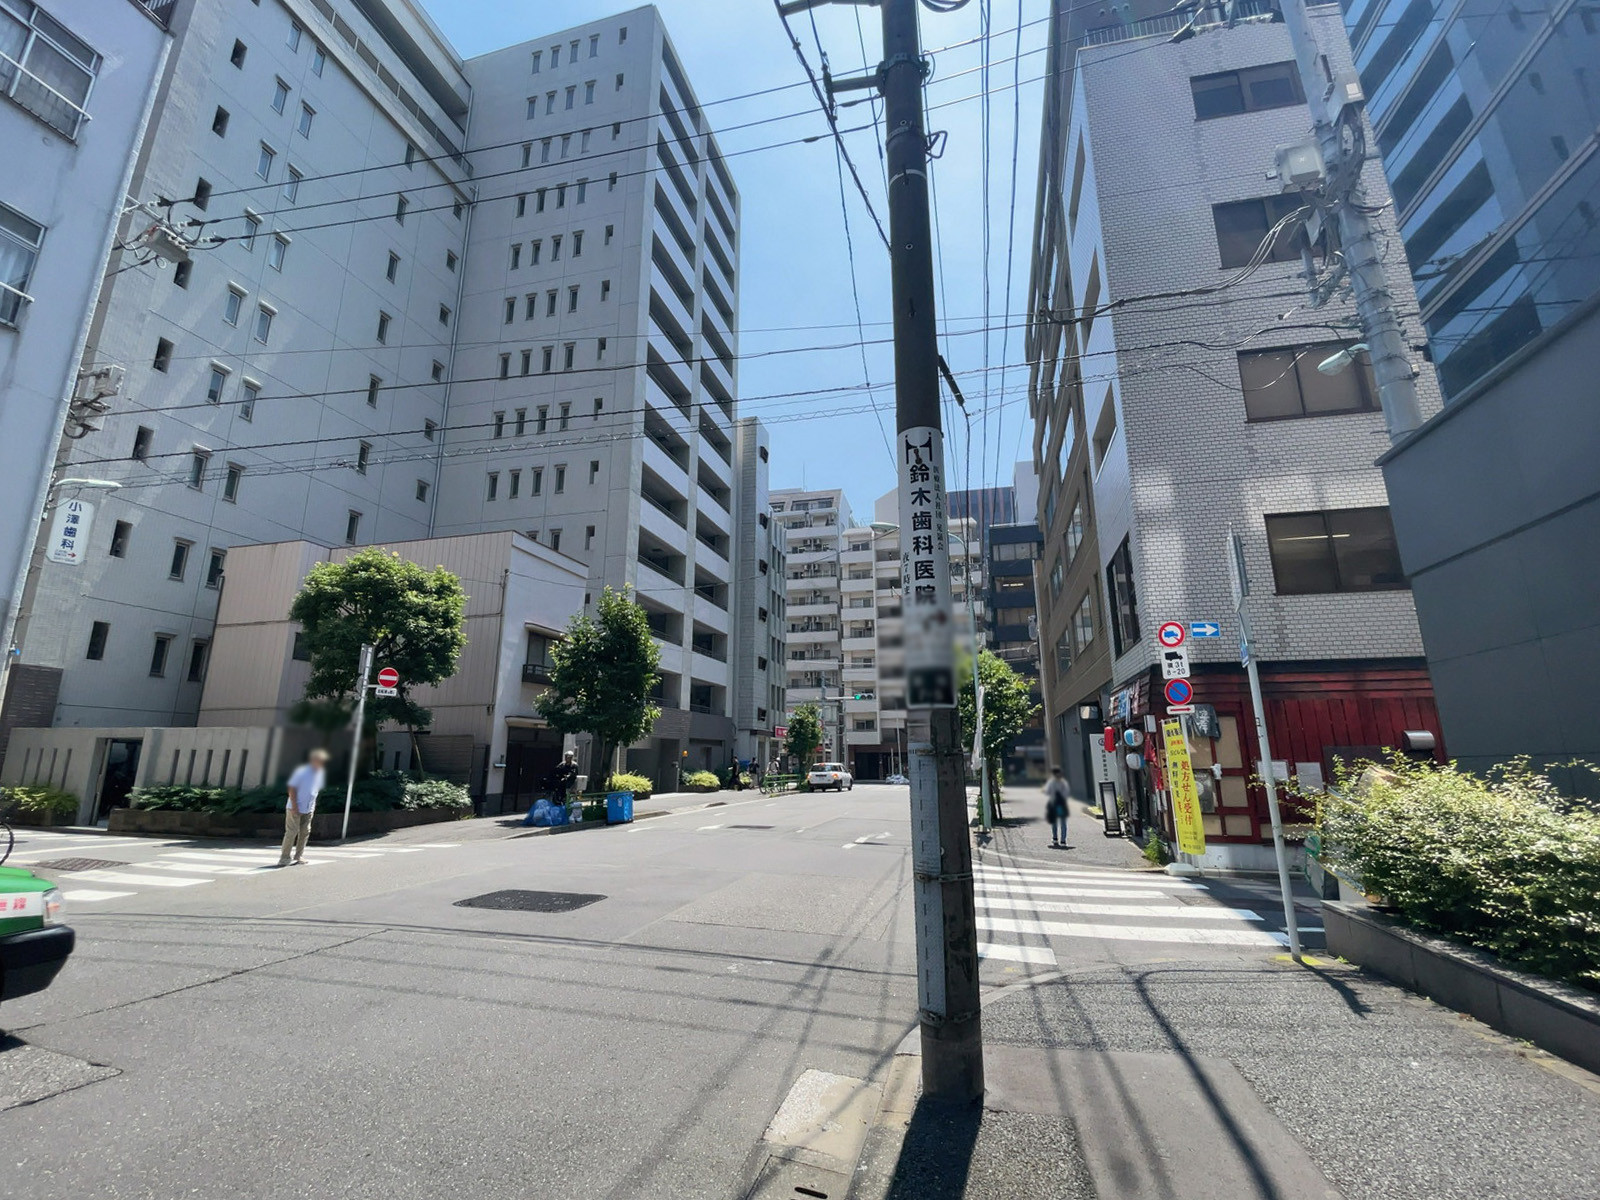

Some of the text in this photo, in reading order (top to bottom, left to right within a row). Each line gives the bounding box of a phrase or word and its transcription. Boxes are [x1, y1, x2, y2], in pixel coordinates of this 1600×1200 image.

[909, 463, 936, 605] 鈴木歯科医院
[1181, 760, 1193, 826] 処方せん受付
